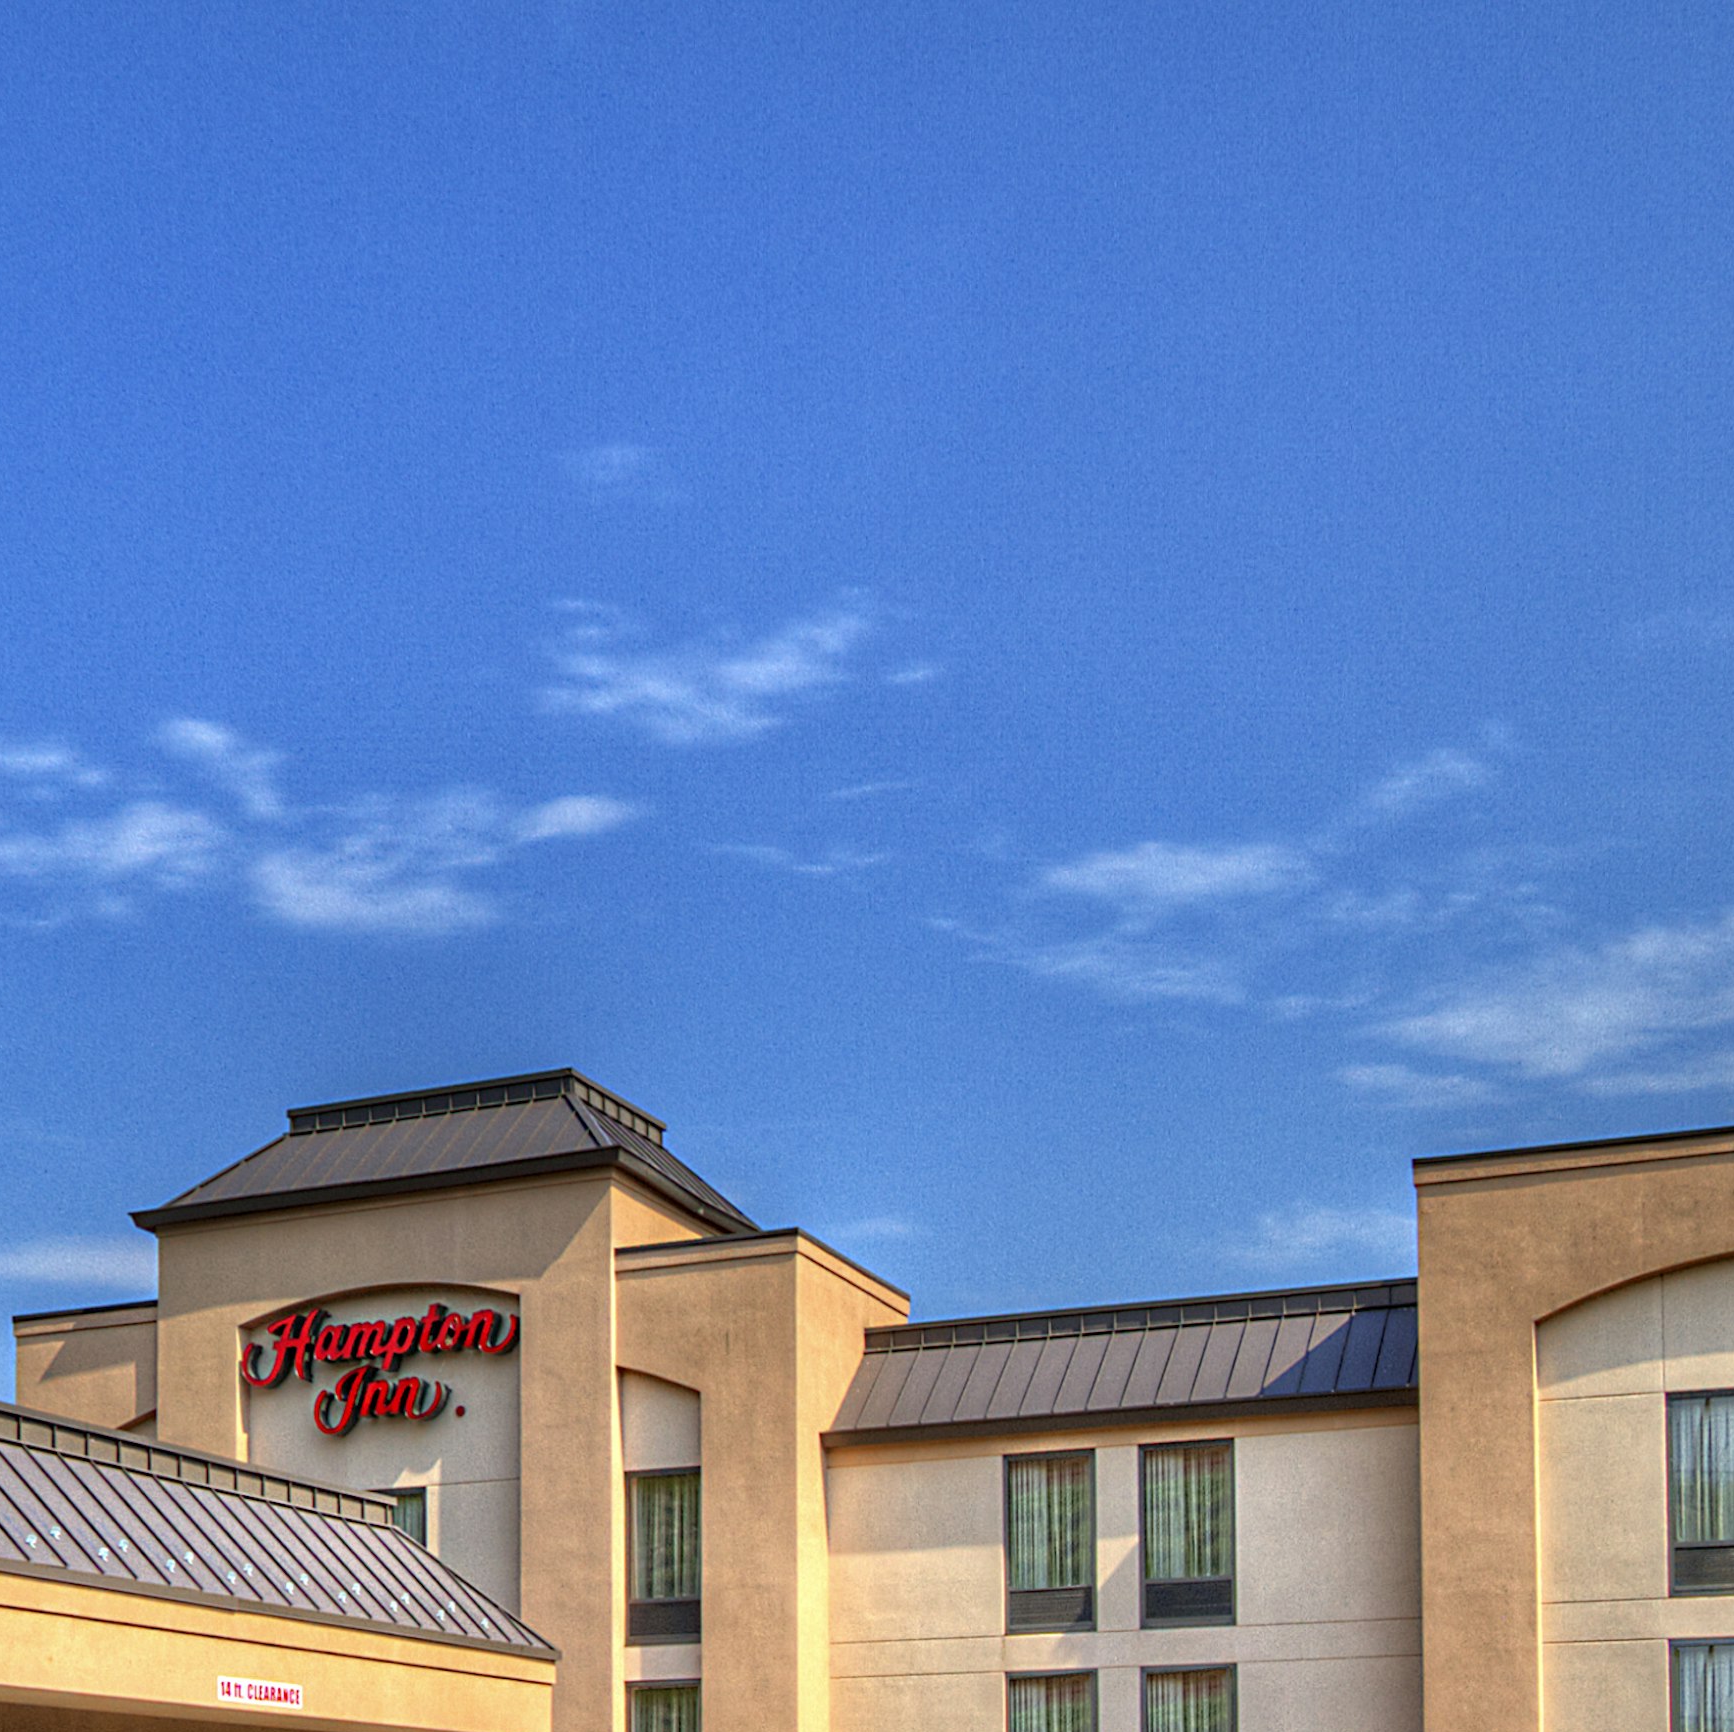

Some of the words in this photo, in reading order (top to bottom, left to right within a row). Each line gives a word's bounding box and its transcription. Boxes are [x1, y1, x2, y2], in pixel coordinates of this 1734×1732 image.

[241, 1303, 520, 1388] Hampton
[220, 1681, 231, 1697] 14
[247, 1684, 300, 1705] CLEARANCE
